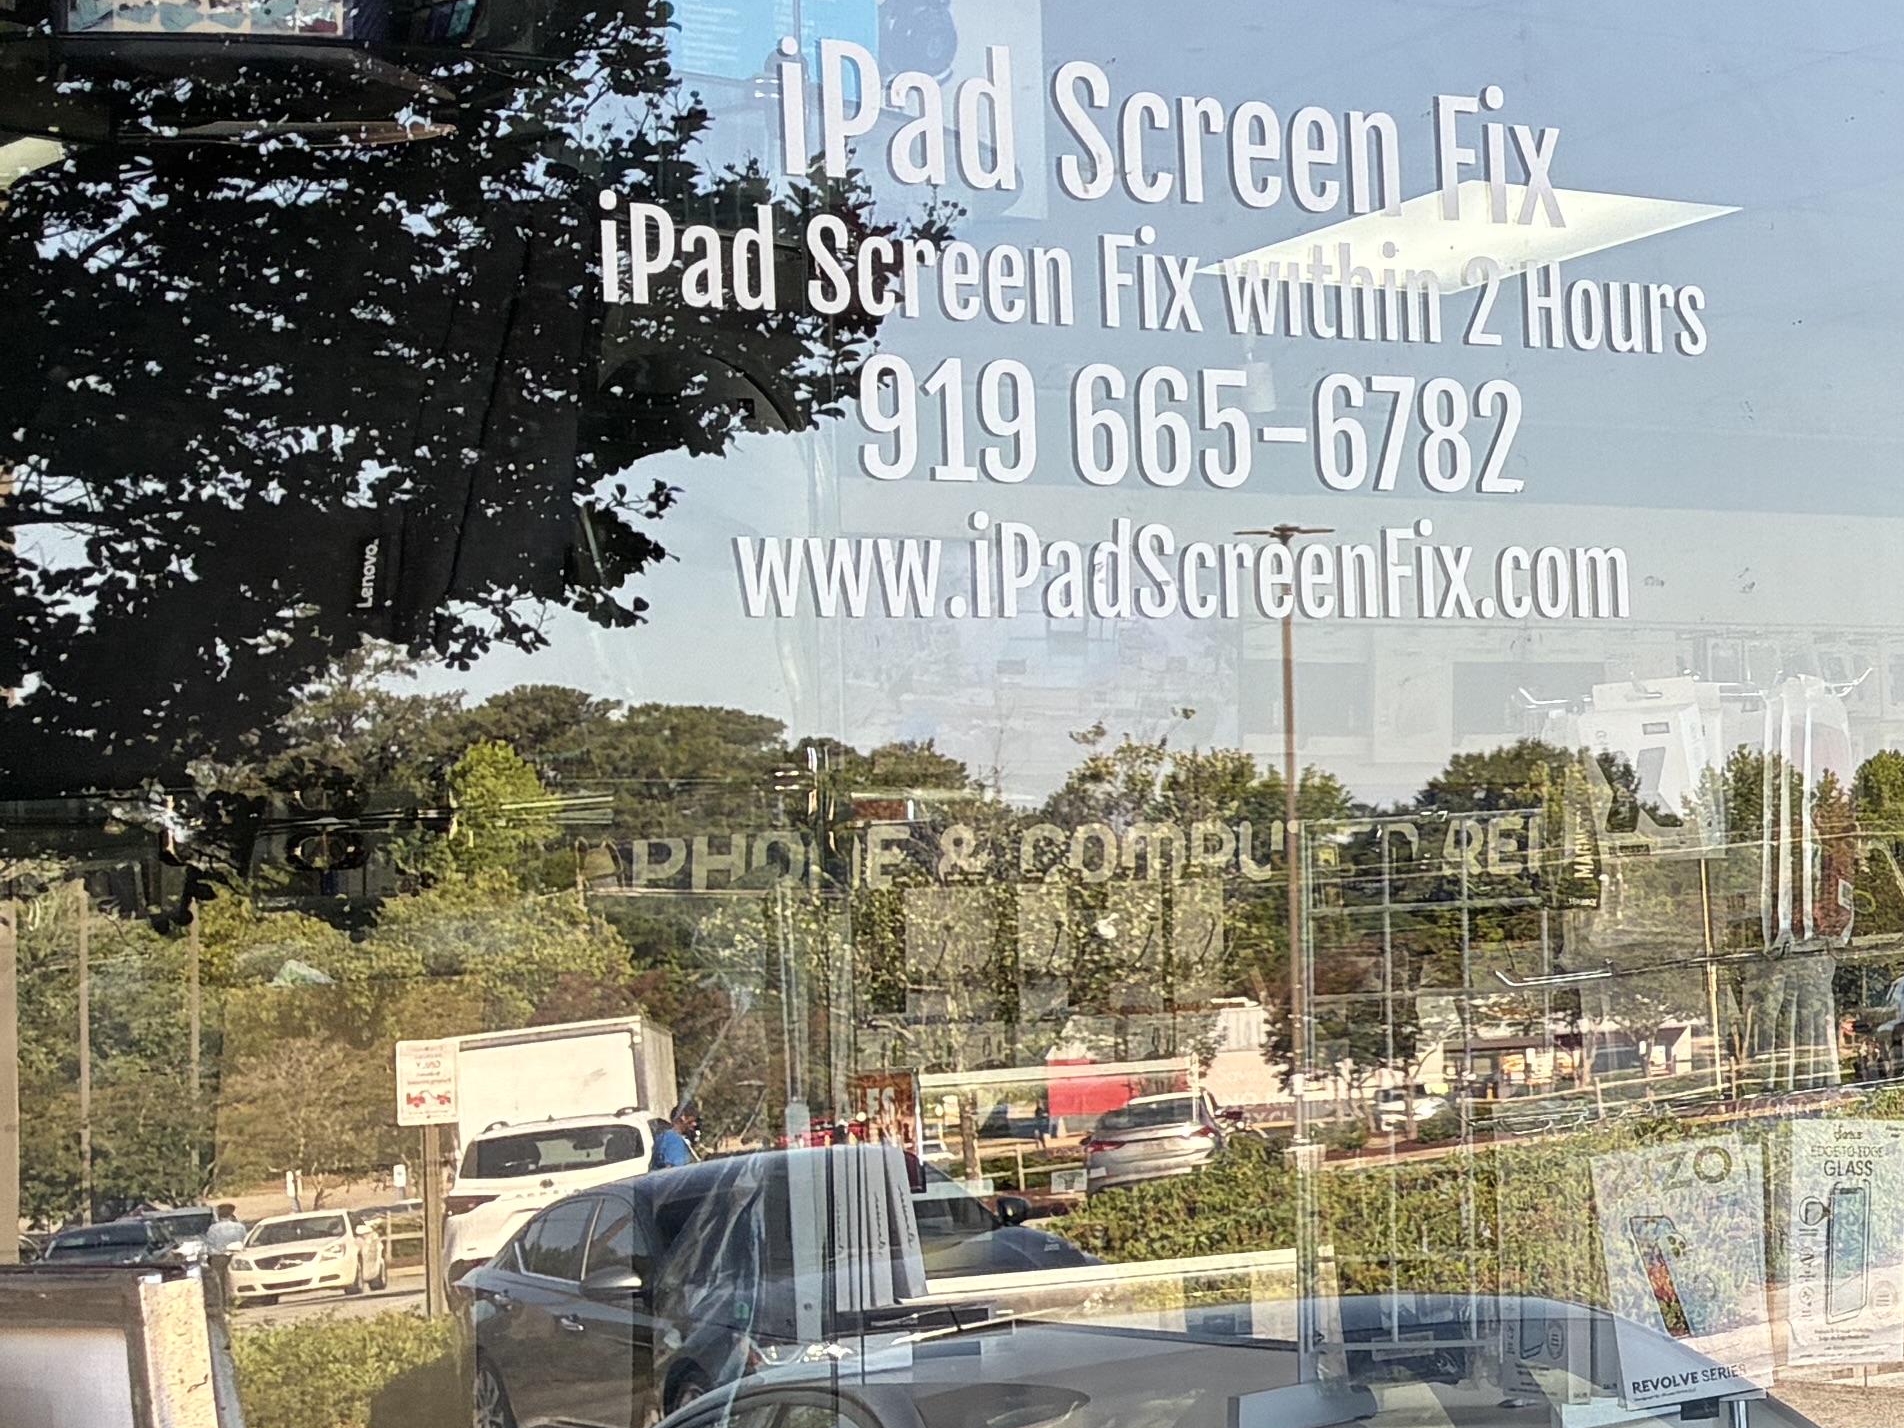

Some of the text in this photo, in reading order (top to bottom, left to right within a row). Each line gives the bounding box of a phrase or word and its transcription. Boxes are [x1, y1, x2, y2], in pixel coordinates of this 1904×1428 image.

[780, 36, 1567, 230] iPad Screen Fix
[600, 190, 1709, 357] iPad Screen Fix within 2 Hours
[859, 357, 1526, 497] 919 665-6782
[356, 542, 378, 608] Lenovo
[736, 509, 1631, 620] www.iPadScreenFix.com
[1823, 1159, 1874, 1178] GLASS
[1631, 1363, 1748, 1394] REVOLVE SERIES
